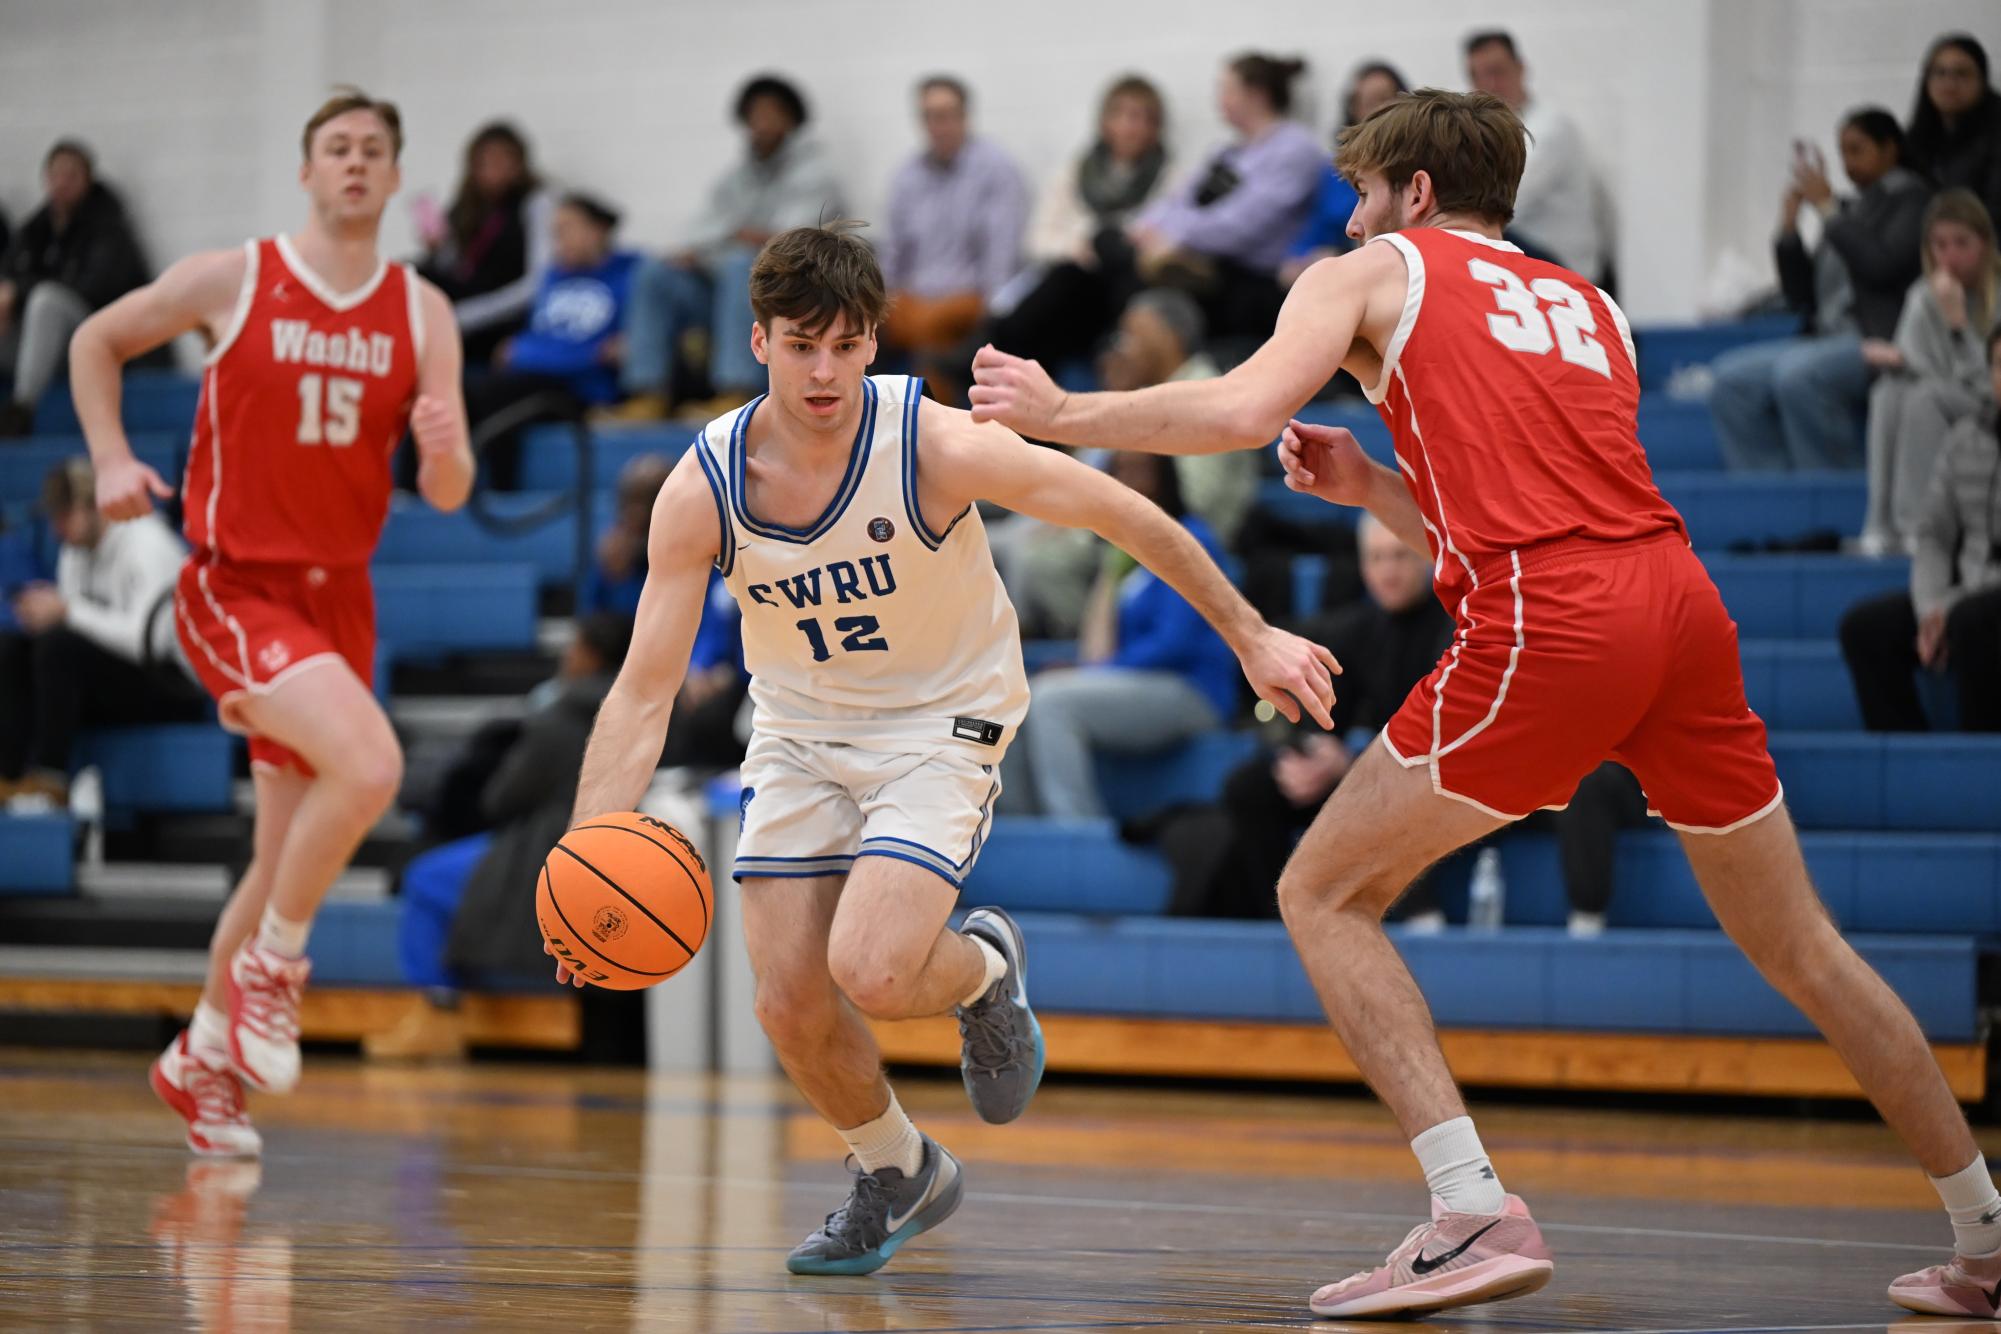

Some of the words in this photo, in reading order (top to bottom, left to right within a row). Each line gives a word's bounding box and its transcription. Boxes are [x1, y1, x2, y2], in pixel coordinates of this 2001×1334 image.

[271, 318, 394, 377] WashU
[1467, 257, 1612, 381] 32
[296, 373, 364, 446] 15
[796, 615, 889, 662] 12
